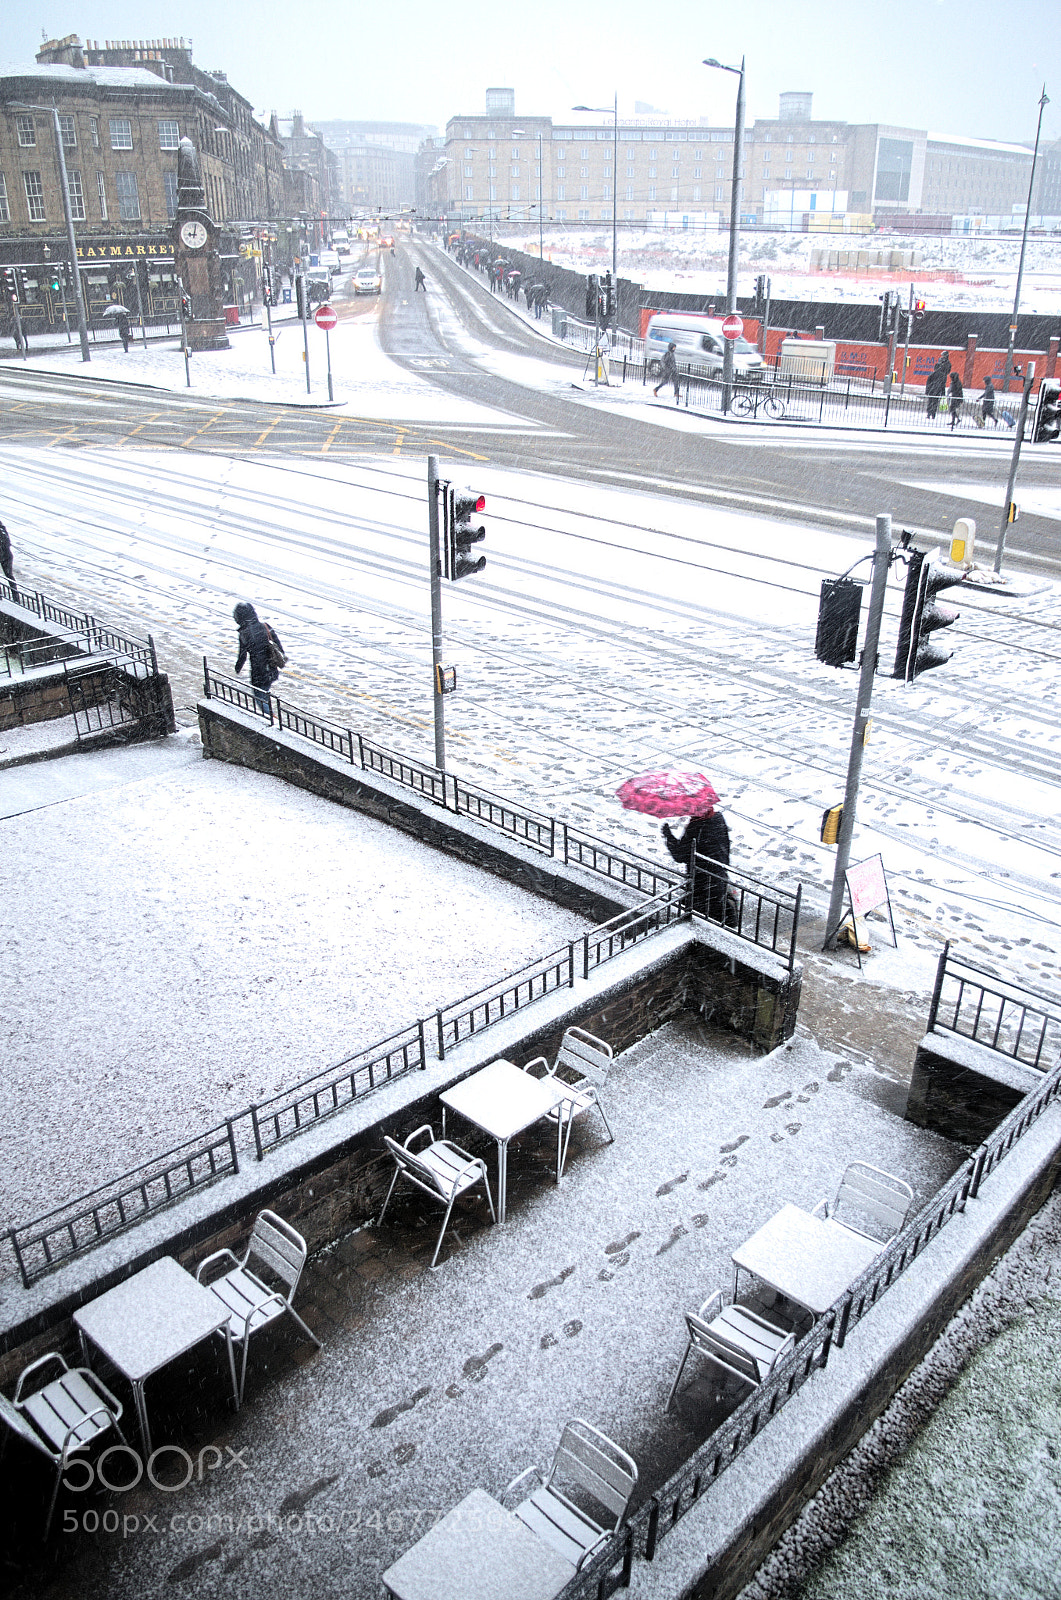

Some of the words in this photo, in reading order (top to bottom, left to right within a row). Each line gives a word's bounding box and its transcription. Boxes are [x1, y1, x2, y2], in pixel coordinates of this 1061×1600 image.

[648, 118, 671, 127] Royal
[674, 118, 697, 126] Hotel
[75, 245, 175, 257] HAYMARKET
